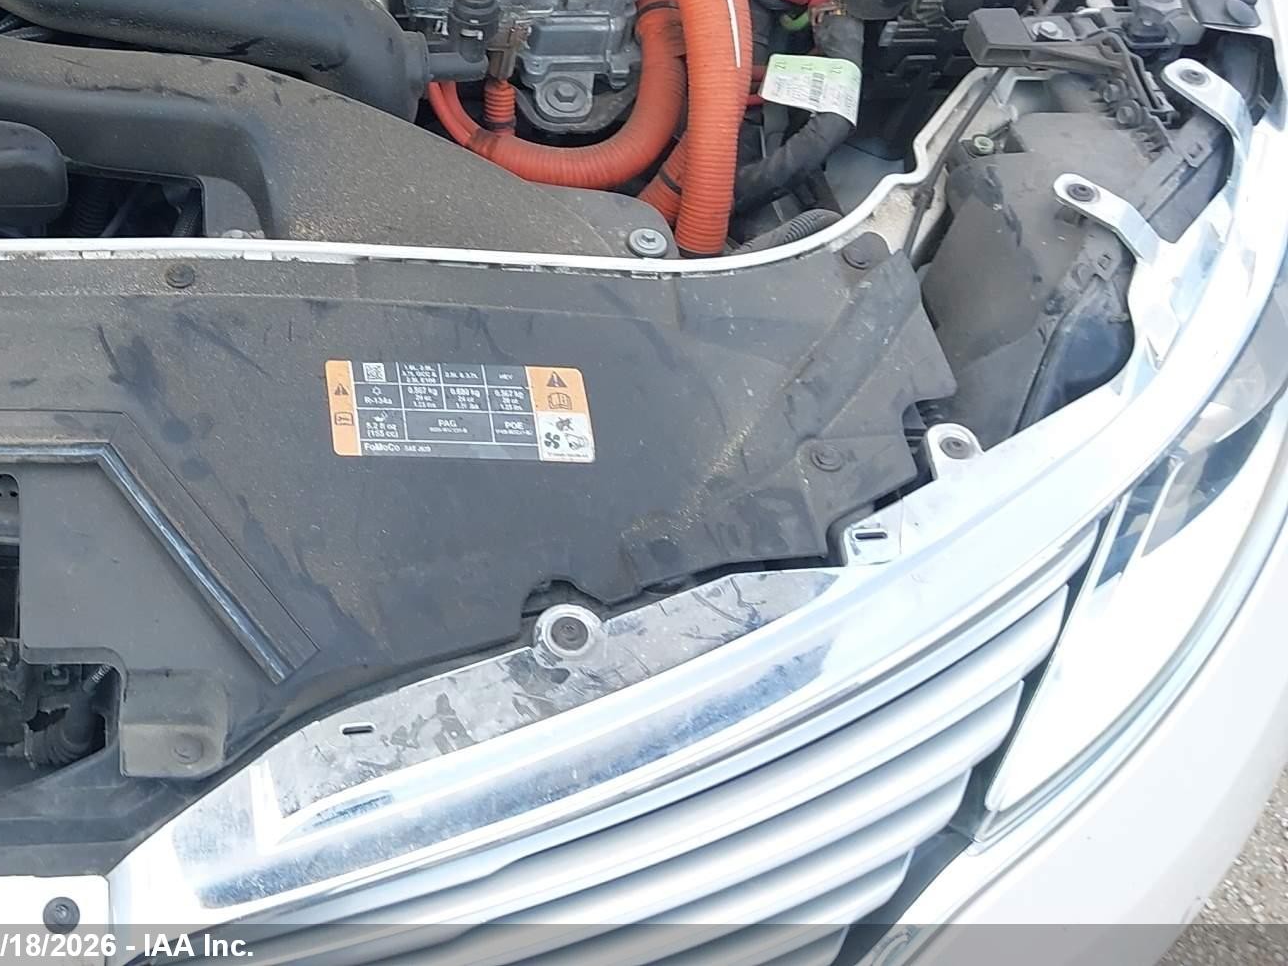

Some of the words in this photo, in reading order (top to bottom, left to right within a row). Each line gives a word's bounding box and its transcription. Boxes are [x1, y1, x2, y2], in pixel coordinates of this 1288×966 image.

[437, 419, 457, 427] PAG
[504, 421, 524, 430] POE
[363, 442, 401, 452] FoMoCo
